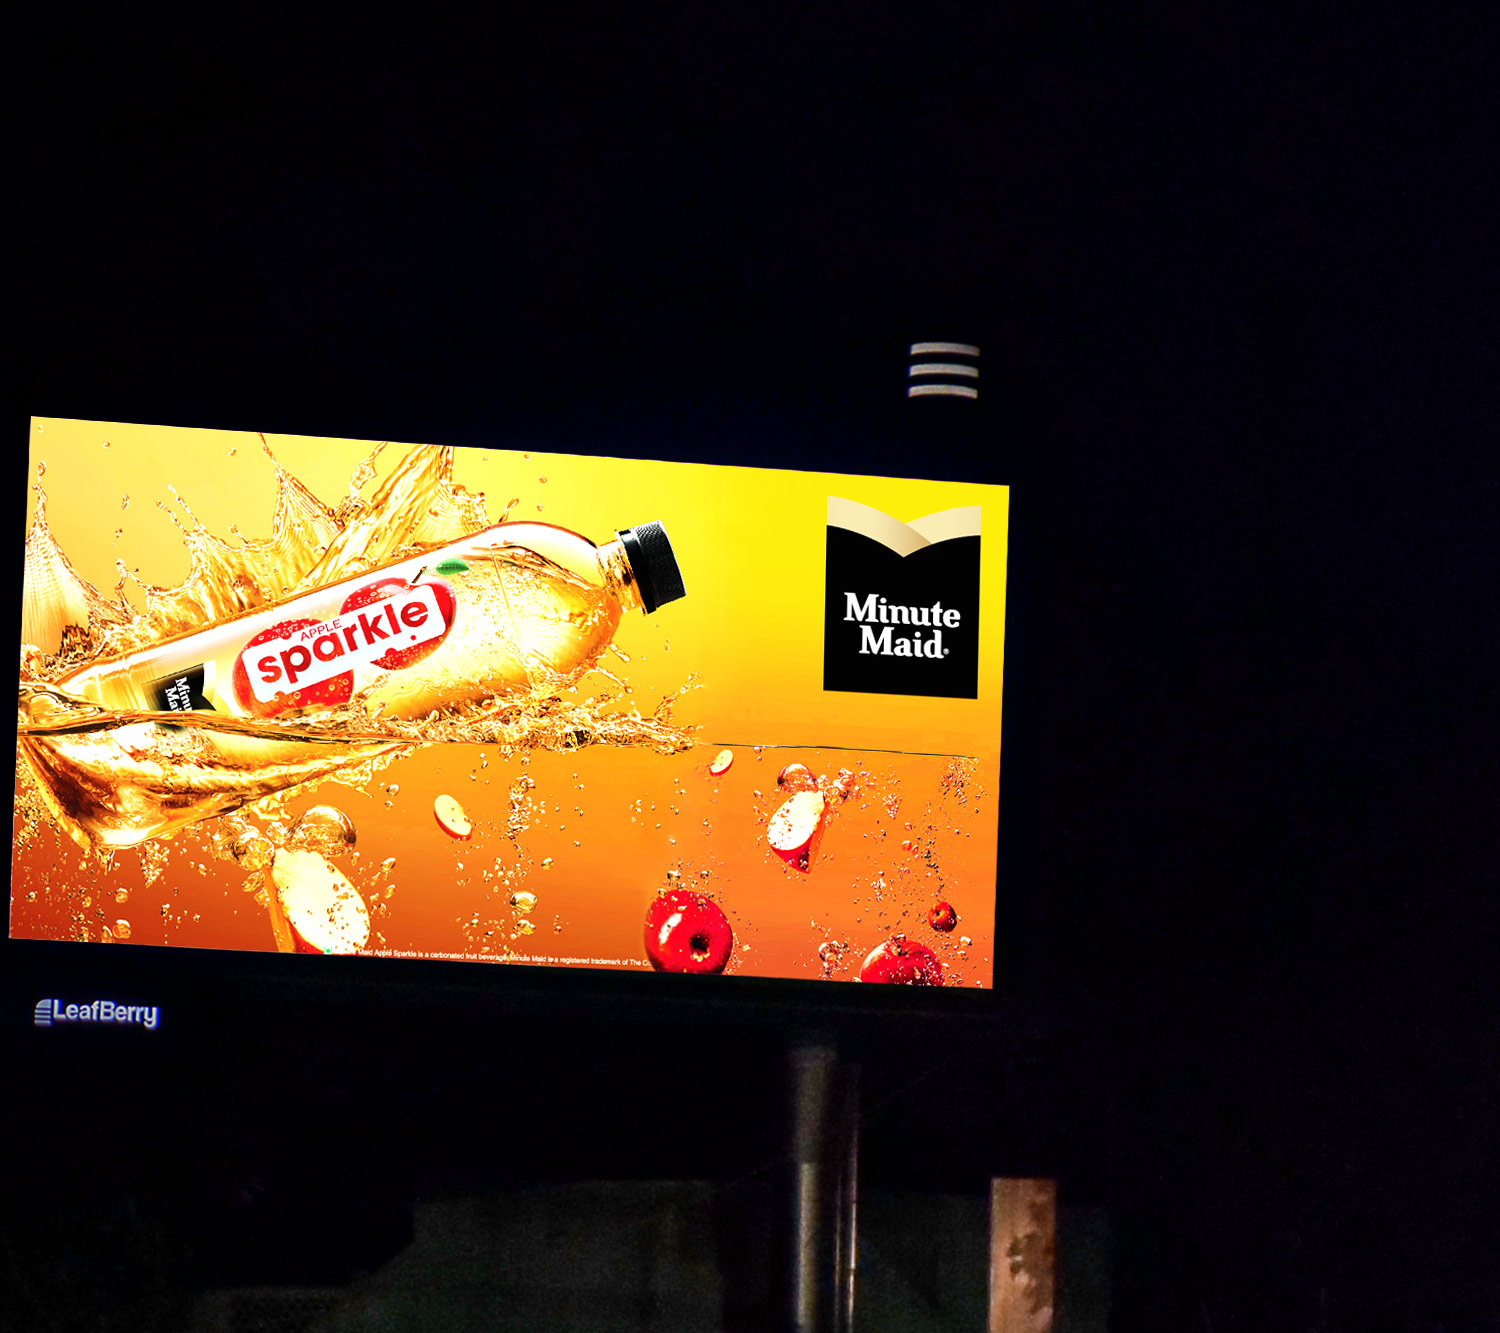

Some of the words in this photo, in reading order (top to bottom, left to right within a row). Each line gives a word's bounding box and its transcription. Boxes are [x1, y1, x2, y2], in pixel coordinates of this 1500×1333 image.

[843, 591, 961, 628] Minute
[256, 601, 429, 685] sparkle
[300, 618, 342, 643] APPLE
[430, 951, 465, 960] carbonated
[560, 956, 590, 965] registered
[591, 957, 622, 966] trademark
[629, 958, 642, 966] The
[53, 999, 159, 1029] LeafBerry
